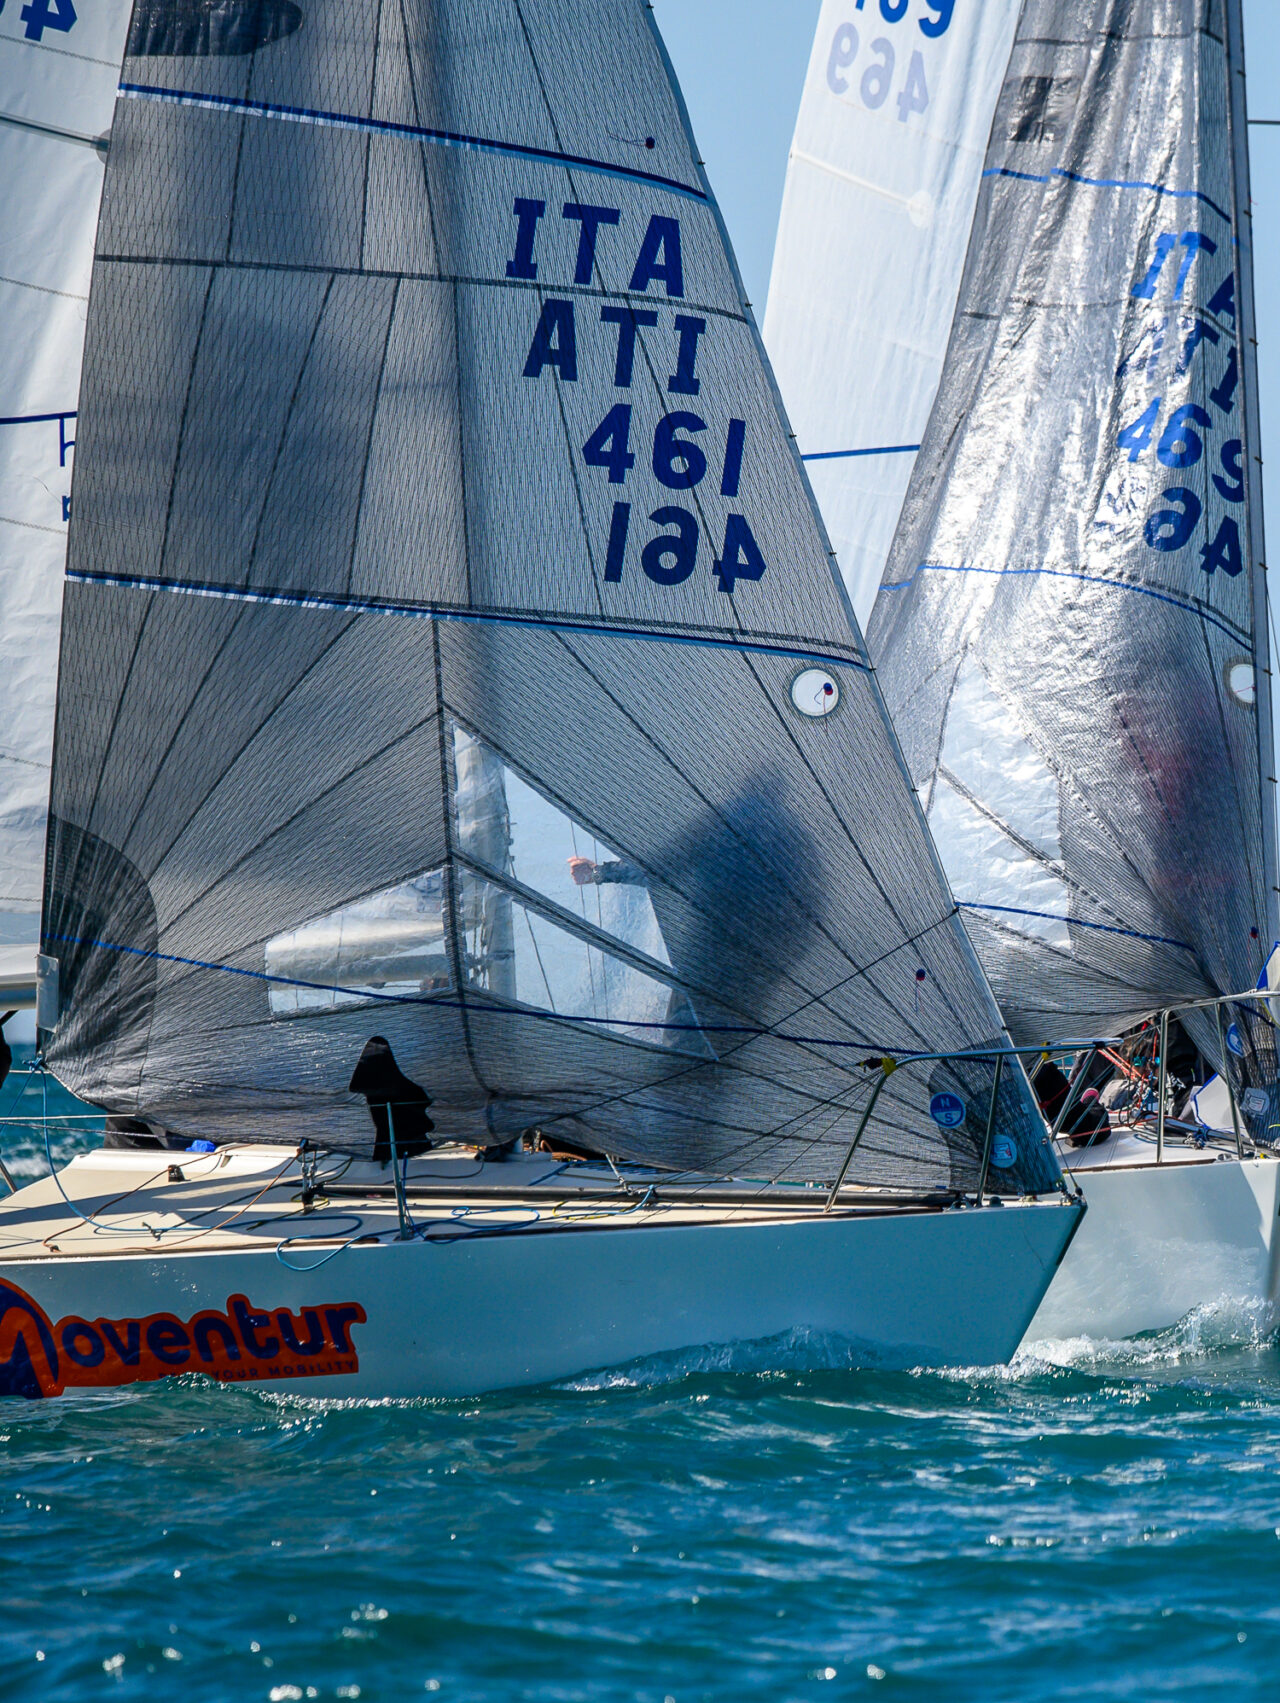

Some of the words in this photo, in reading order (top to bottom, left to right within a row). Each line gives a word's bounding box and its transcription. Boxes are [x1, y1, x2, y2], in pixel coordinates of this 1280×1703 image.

[506, 197, 685, 298] ITA
[582, 403, 746, 497] 461
[268, 1360, 354, 1377] MOBILITY
